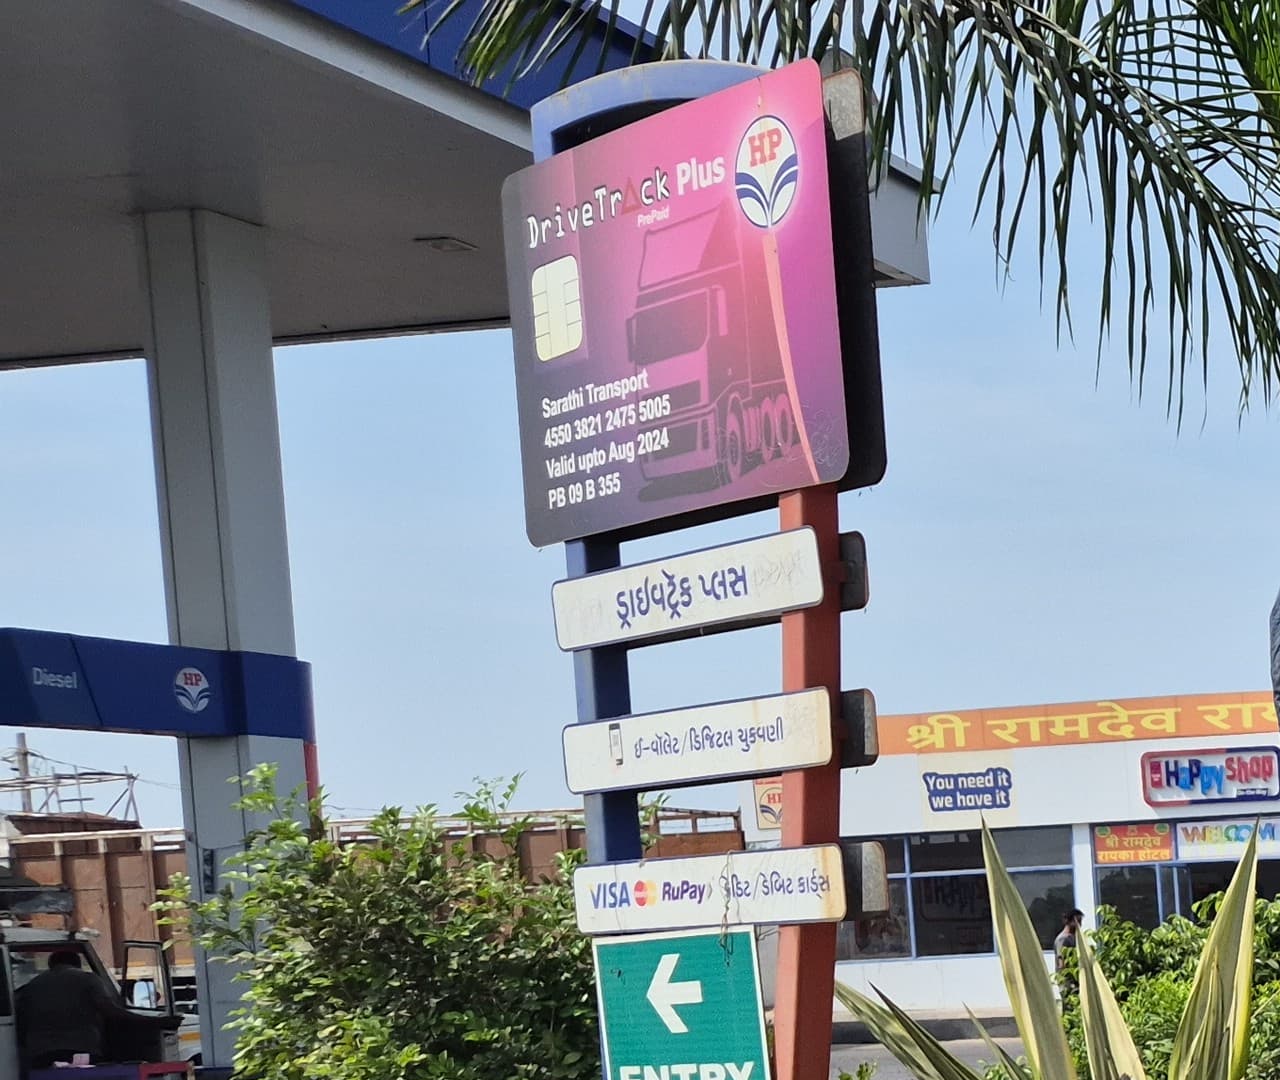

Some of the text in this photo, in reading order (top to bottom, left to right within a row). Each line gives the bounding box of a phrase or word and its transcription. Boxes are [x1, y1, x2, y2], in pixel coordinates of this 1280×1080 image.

[747, 126, 784, 168] HP
[676, 156, 726, 196] Plus
[637, 205, 670, 229] PrePaid
[541, 367, 650, 419] Sarathi Transport
[544, 393, 672, 449] 4550 3821 2475 5005
[545, 426, 670, 479] Valid upto Aug 2024
[548, 471, 621, 510] PB 09 B 355
[698, 565, 749, 601] પ્લસ
[31, 667, 78, 689] Diesel
[183, 671, 203, 687] HP
[906, 714, 972, 749] श्री
[986, 701, 1182, 745] रामदेव
[926, 770, 1009, 791] You need it
[932, 789, 1007, 809] we have it
[589, 880, 631, 910] VISA
[661, 879, 706, 905] RuPay
